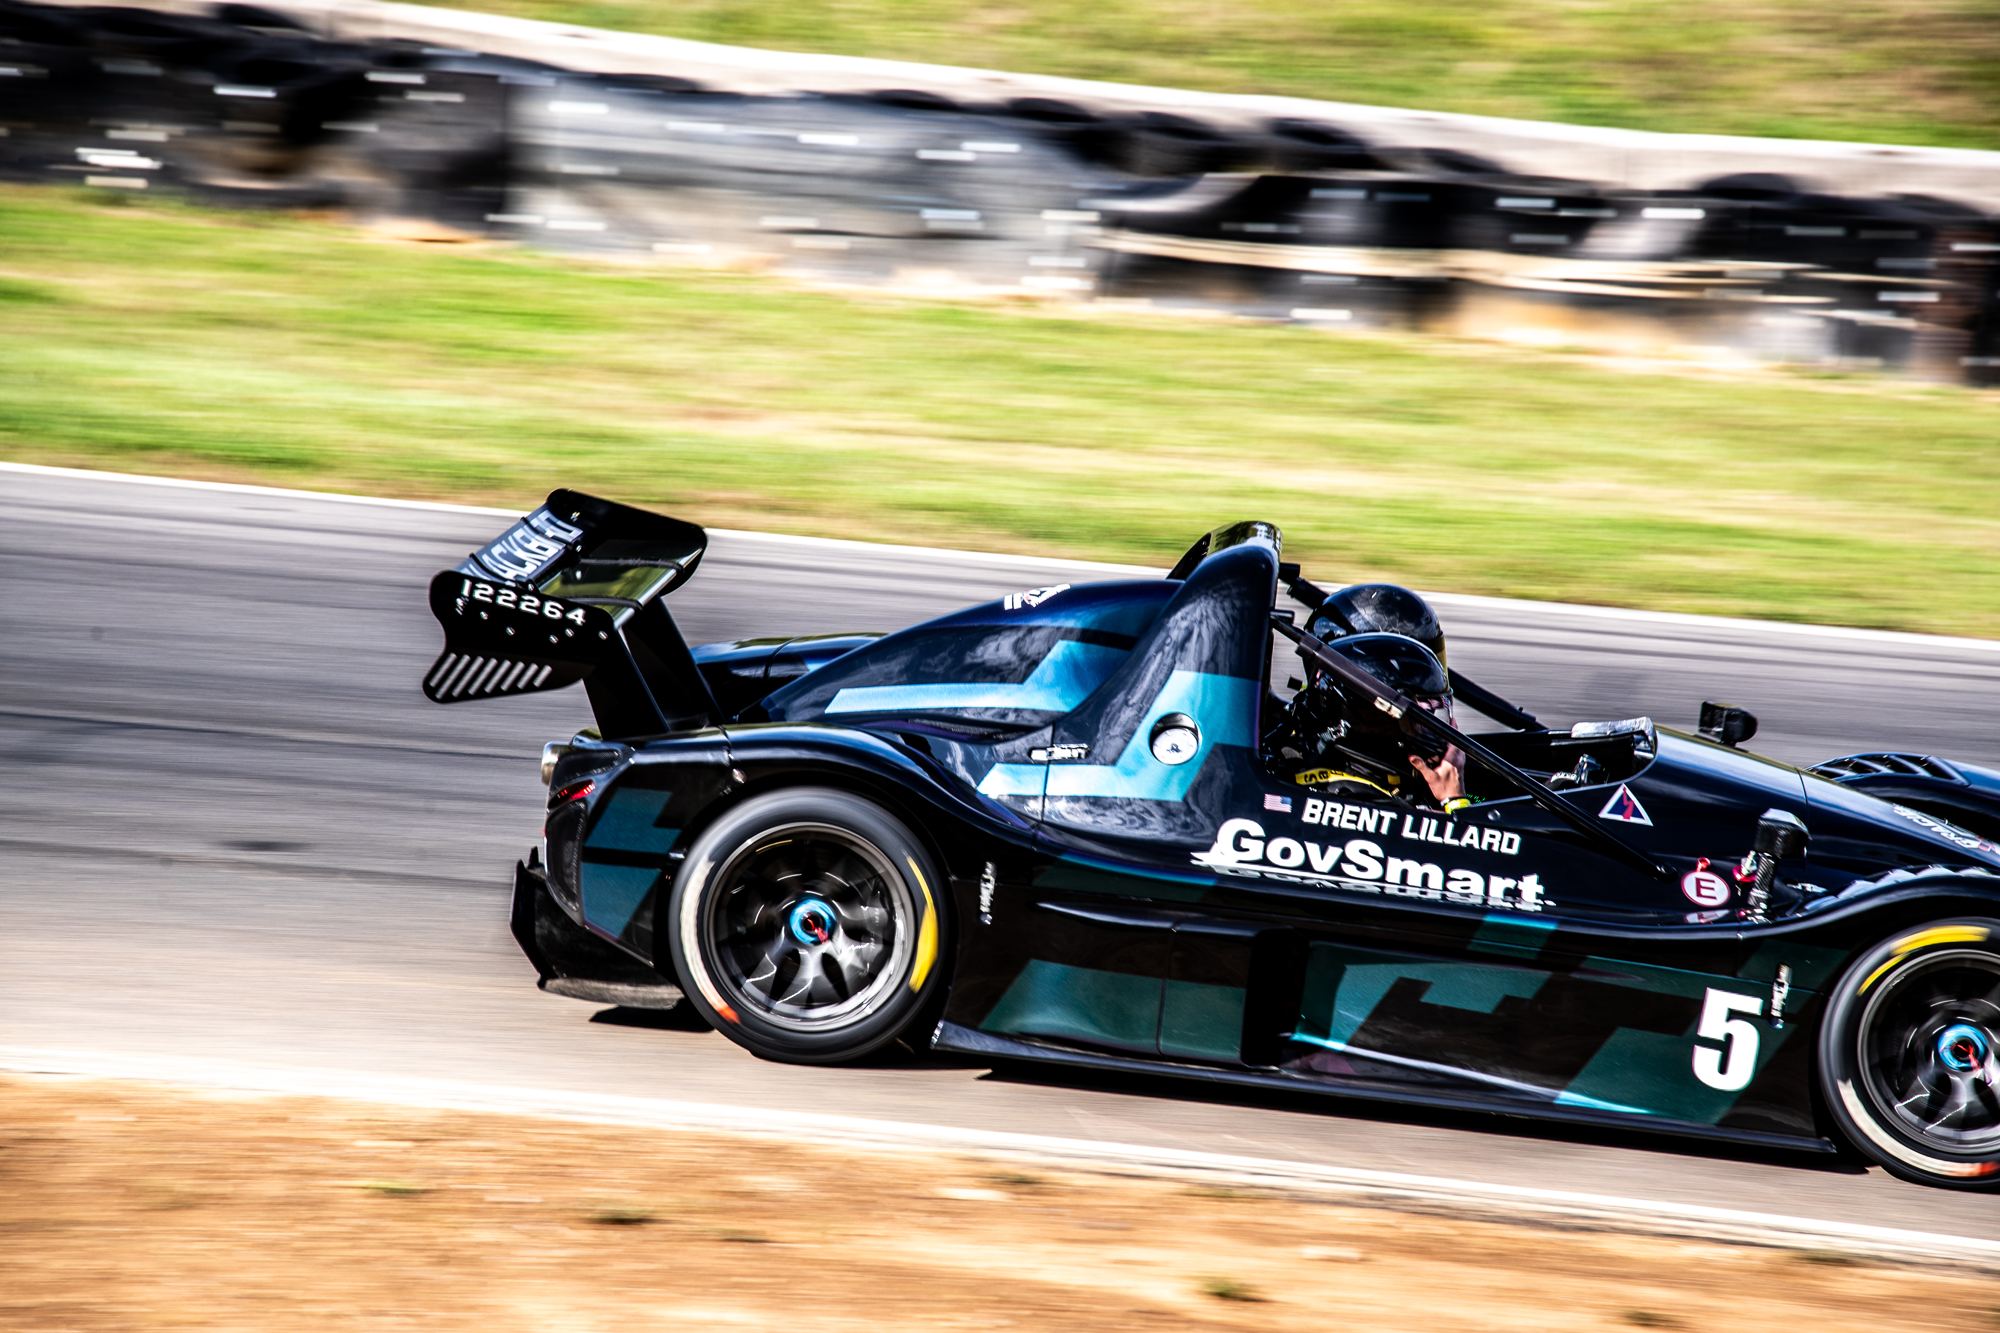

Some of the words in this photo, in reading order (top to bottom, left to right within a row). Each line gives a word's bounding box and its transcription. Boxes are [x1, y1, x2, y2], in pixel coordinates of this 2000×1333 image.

[461, 579, 586, 626] 122264
[1301, 797, 1398, 835] BRENT
[1401, 813, 1522, 855] LILLARD
[1213, 817, 1546, 909] GovSmart
[1694, 876, 1717, 900] E
[1692, 986, 1764, 1092] 5
